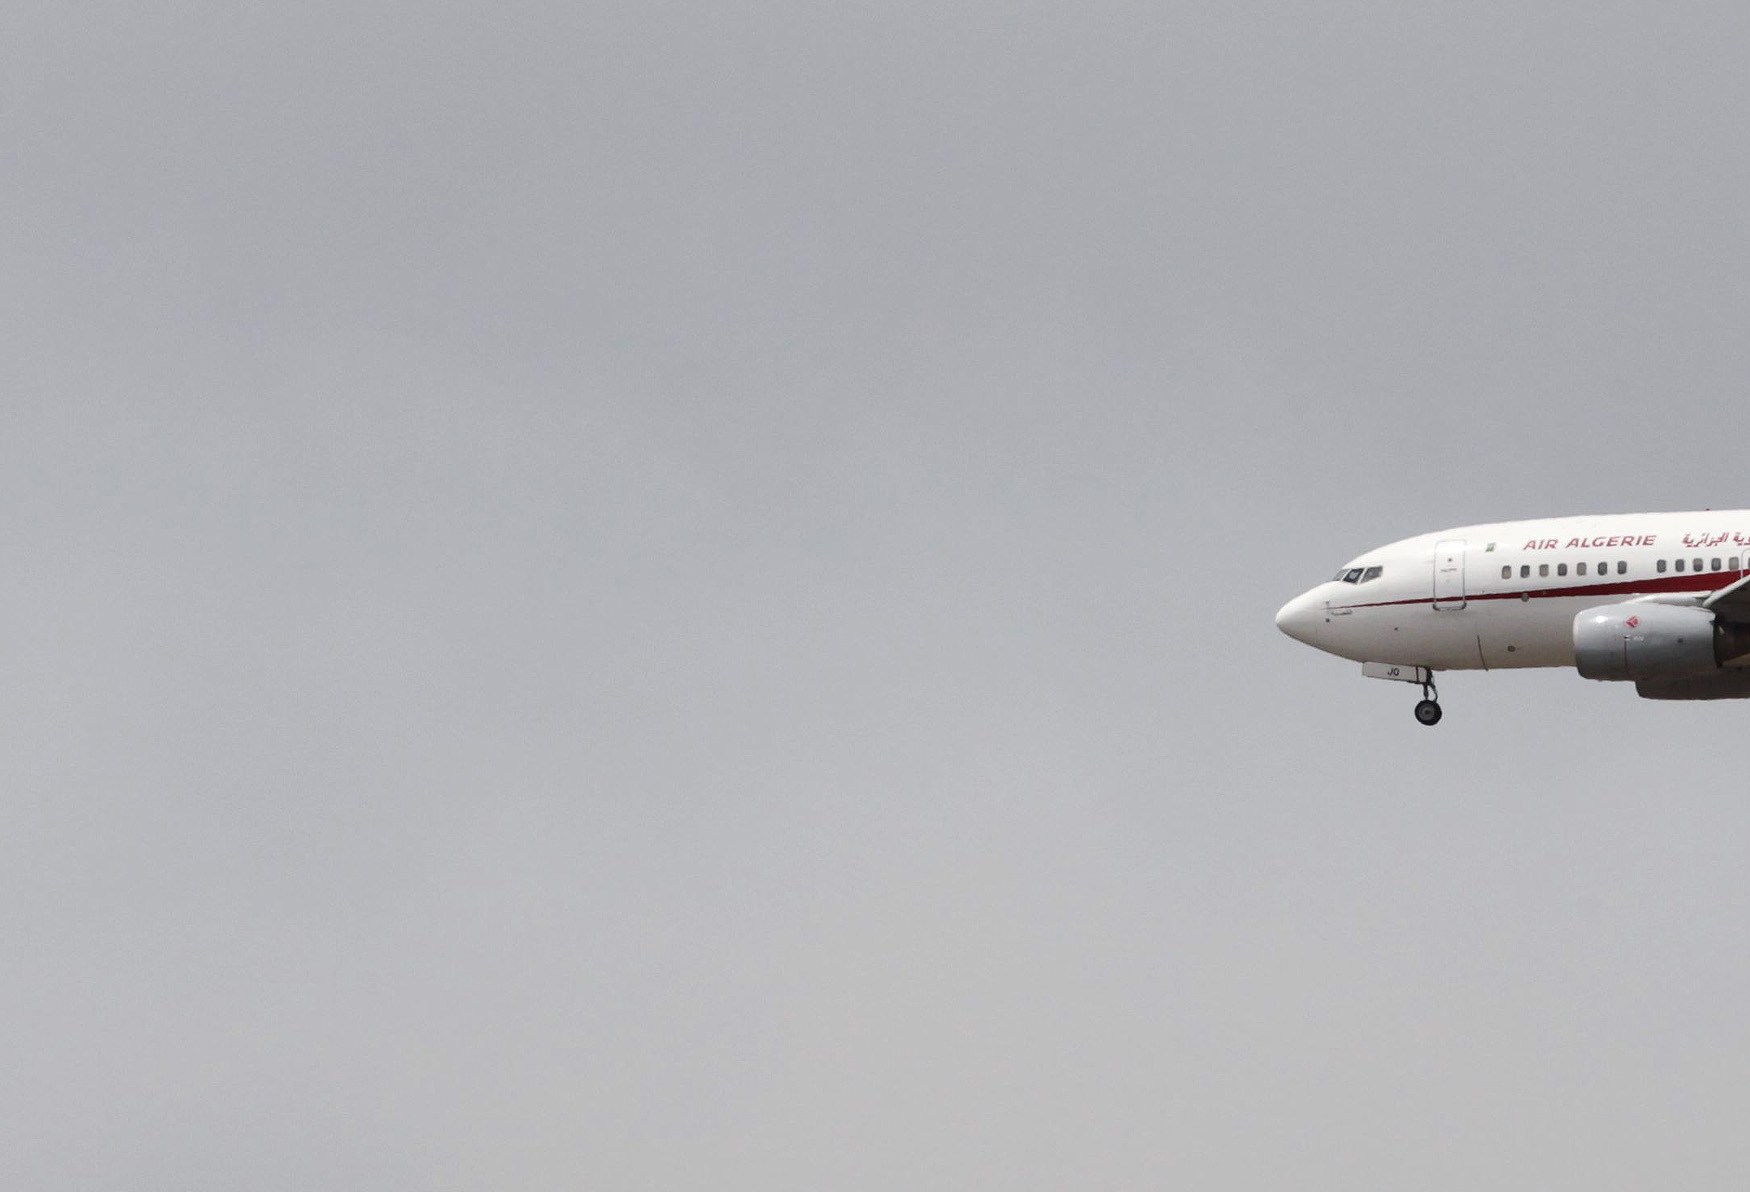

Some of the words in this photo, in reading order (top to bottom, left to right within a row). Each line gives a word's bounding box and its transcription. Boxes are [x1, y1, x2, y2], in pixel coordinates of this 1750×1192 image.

[1523, 539, 1558, 550] AIR
[1565, 535, 1656, 549] ALGERIE
[1682, 532, 1729, 548] الجزائرية
